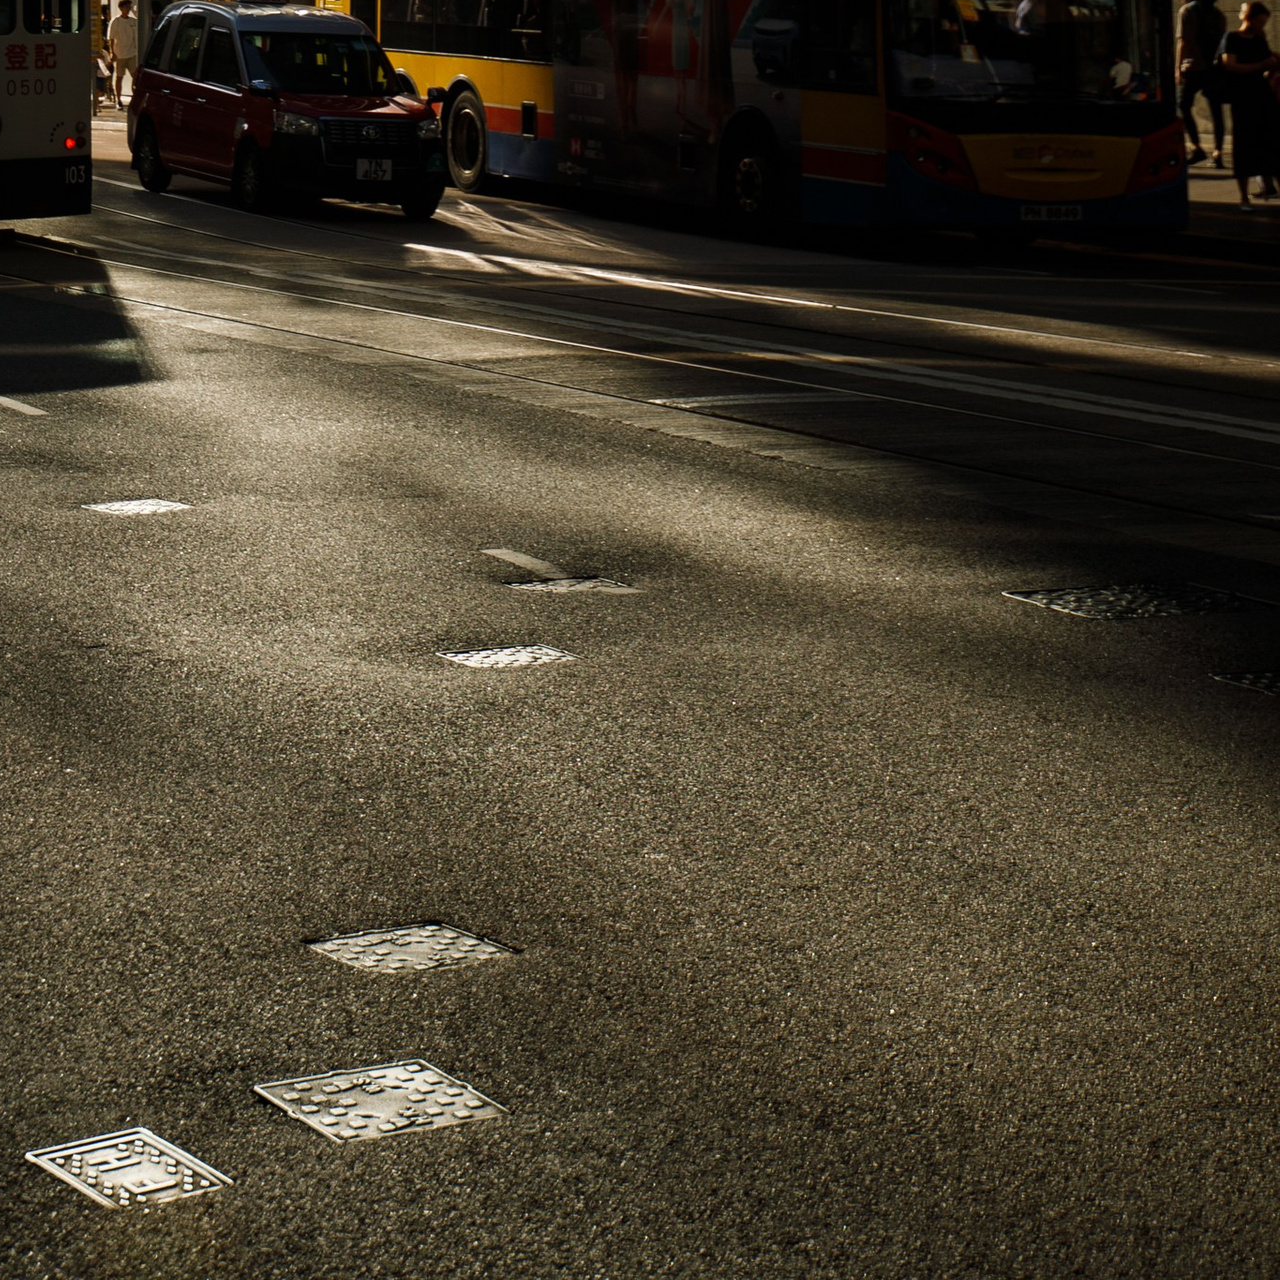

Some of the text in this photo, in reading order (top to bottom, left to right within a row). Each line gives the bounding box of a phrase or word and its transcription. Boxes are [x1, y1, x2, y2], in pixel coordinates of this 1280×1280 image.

[4, 44, 57, 70] 登記
[7, 78, 57, 96] 0500
[368, 158, 384, 171] YN
[64, 165, 86, 184] 103
